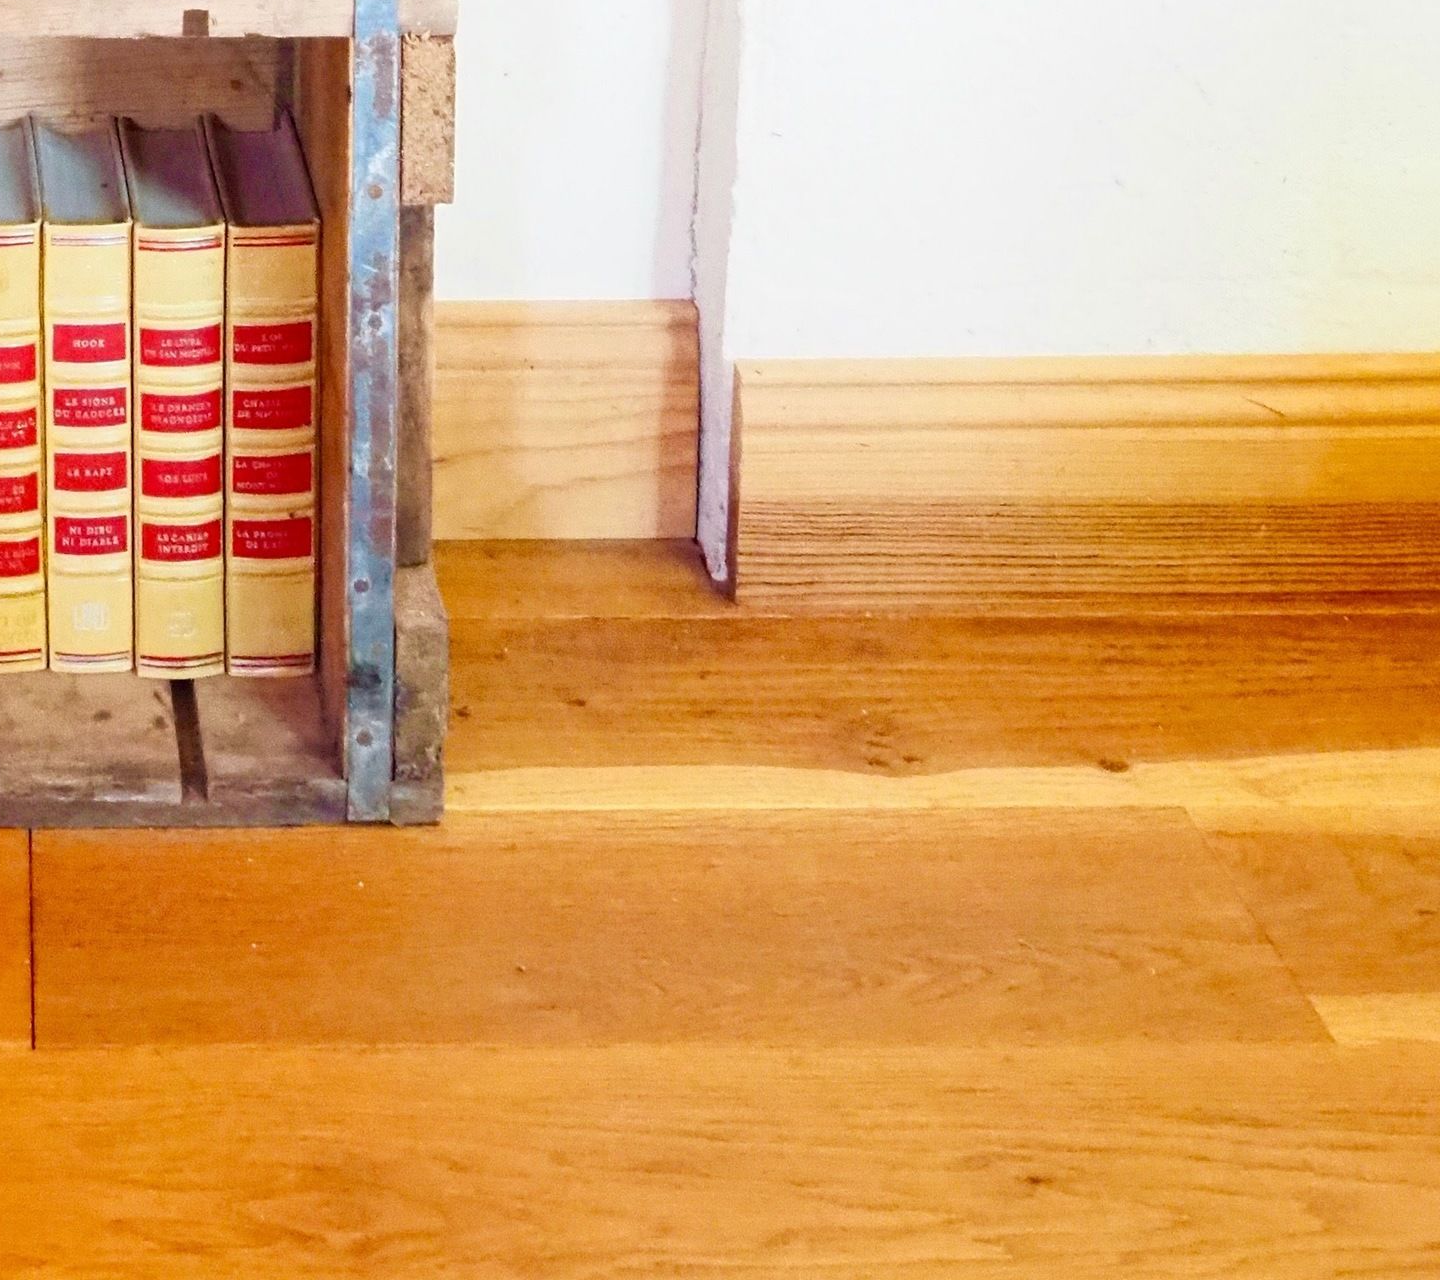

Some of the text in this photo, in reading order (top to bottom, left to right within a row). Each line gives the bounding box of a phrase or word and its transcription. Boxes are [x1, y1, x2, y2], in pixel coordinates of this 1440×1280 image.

[69, 526, 113, 535] NI DIEU
[62, 536, 120, 546] NI DIABLE
